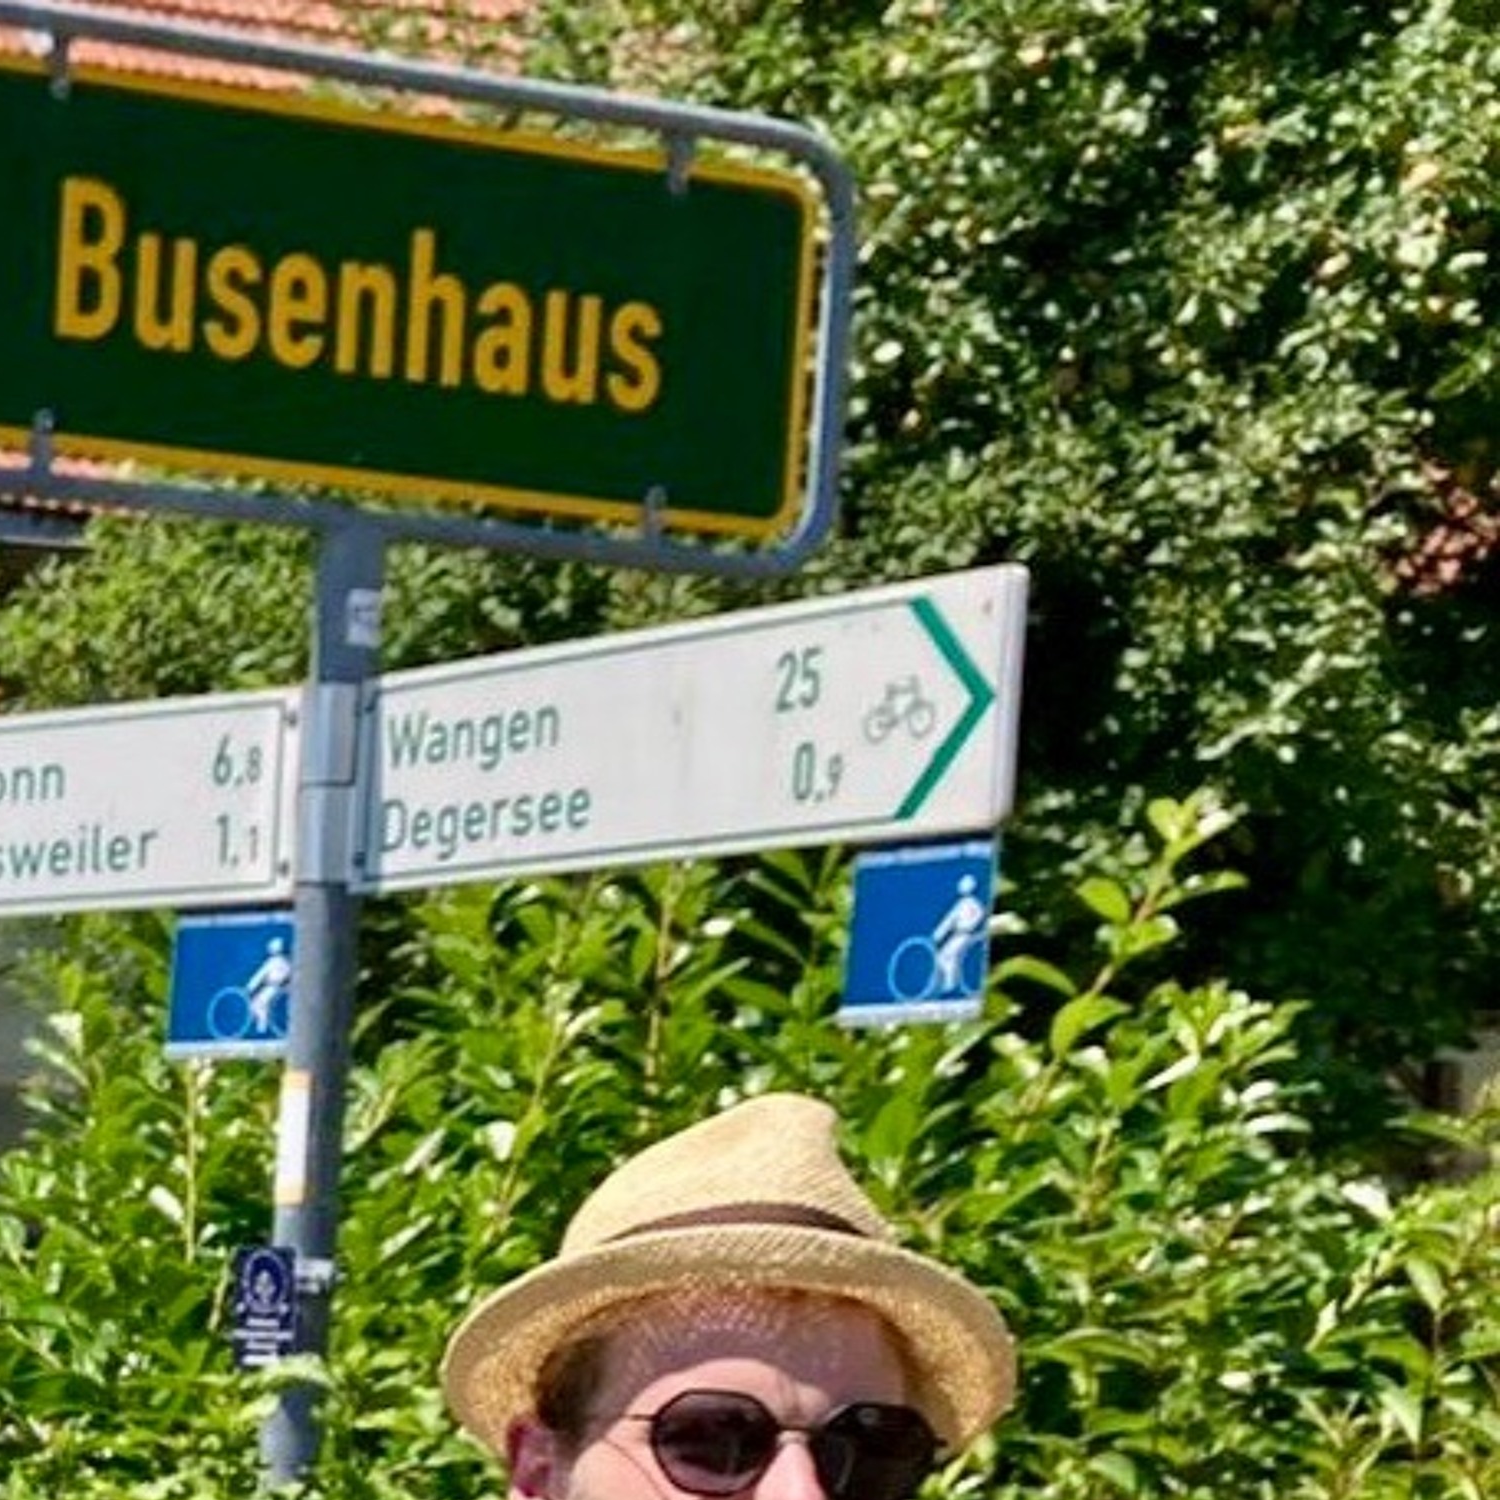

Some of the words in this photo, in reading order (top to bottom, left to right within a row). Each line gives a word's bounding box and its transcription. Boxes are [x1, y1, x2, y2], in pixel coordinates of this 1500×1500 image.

[54, 174, 663, 411] Busenhaus
[211, 733, 264, 789] 6,8
[385, 702, 560, 772] Wangen
[774, 646, 823, 714] 25
[213, 813, 262, 872] 1,1
[379, 787, 591, 859] Degersee
[791, 741, 844, 804] 0,9
